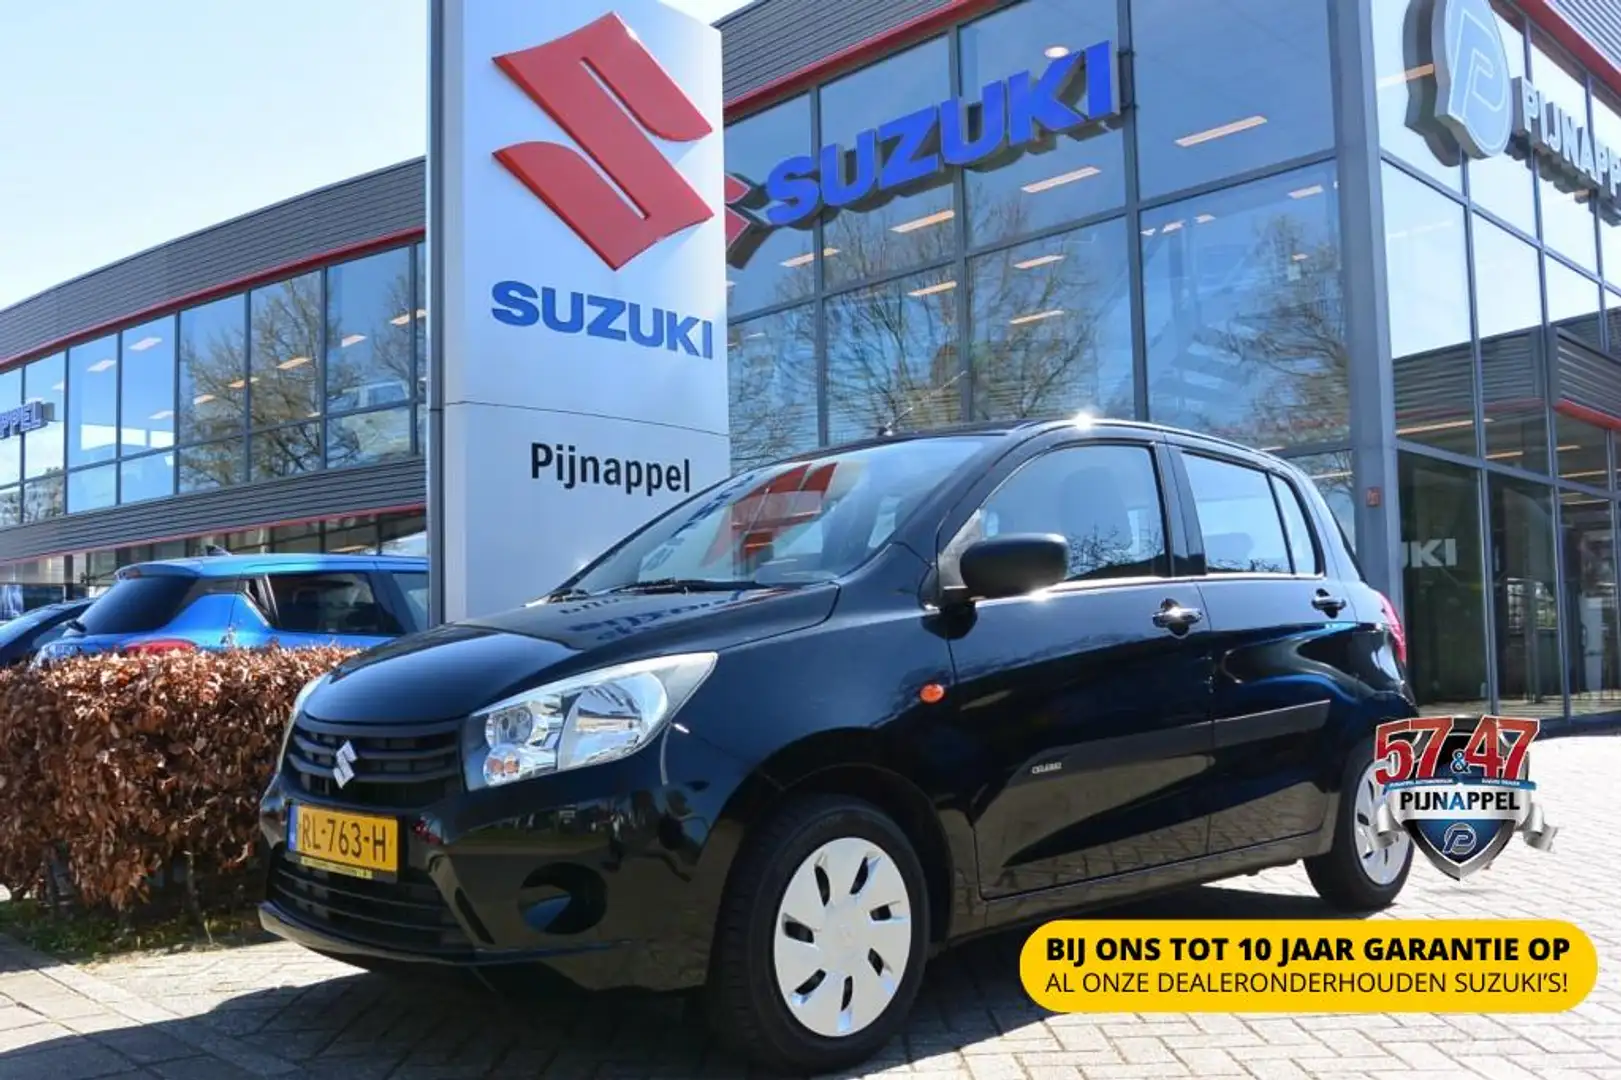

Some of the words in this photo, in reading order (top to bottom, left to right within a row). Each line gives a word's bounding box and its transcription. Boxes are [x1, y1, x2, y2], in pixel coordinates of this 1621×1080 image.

[766, 40, 1115, 226] SUZUKI
[491, 280, 713, 359] SUZUKI
[530, 442, 691, 496] Pijnappel
[301, 812, 386, 863] RL-763-H
